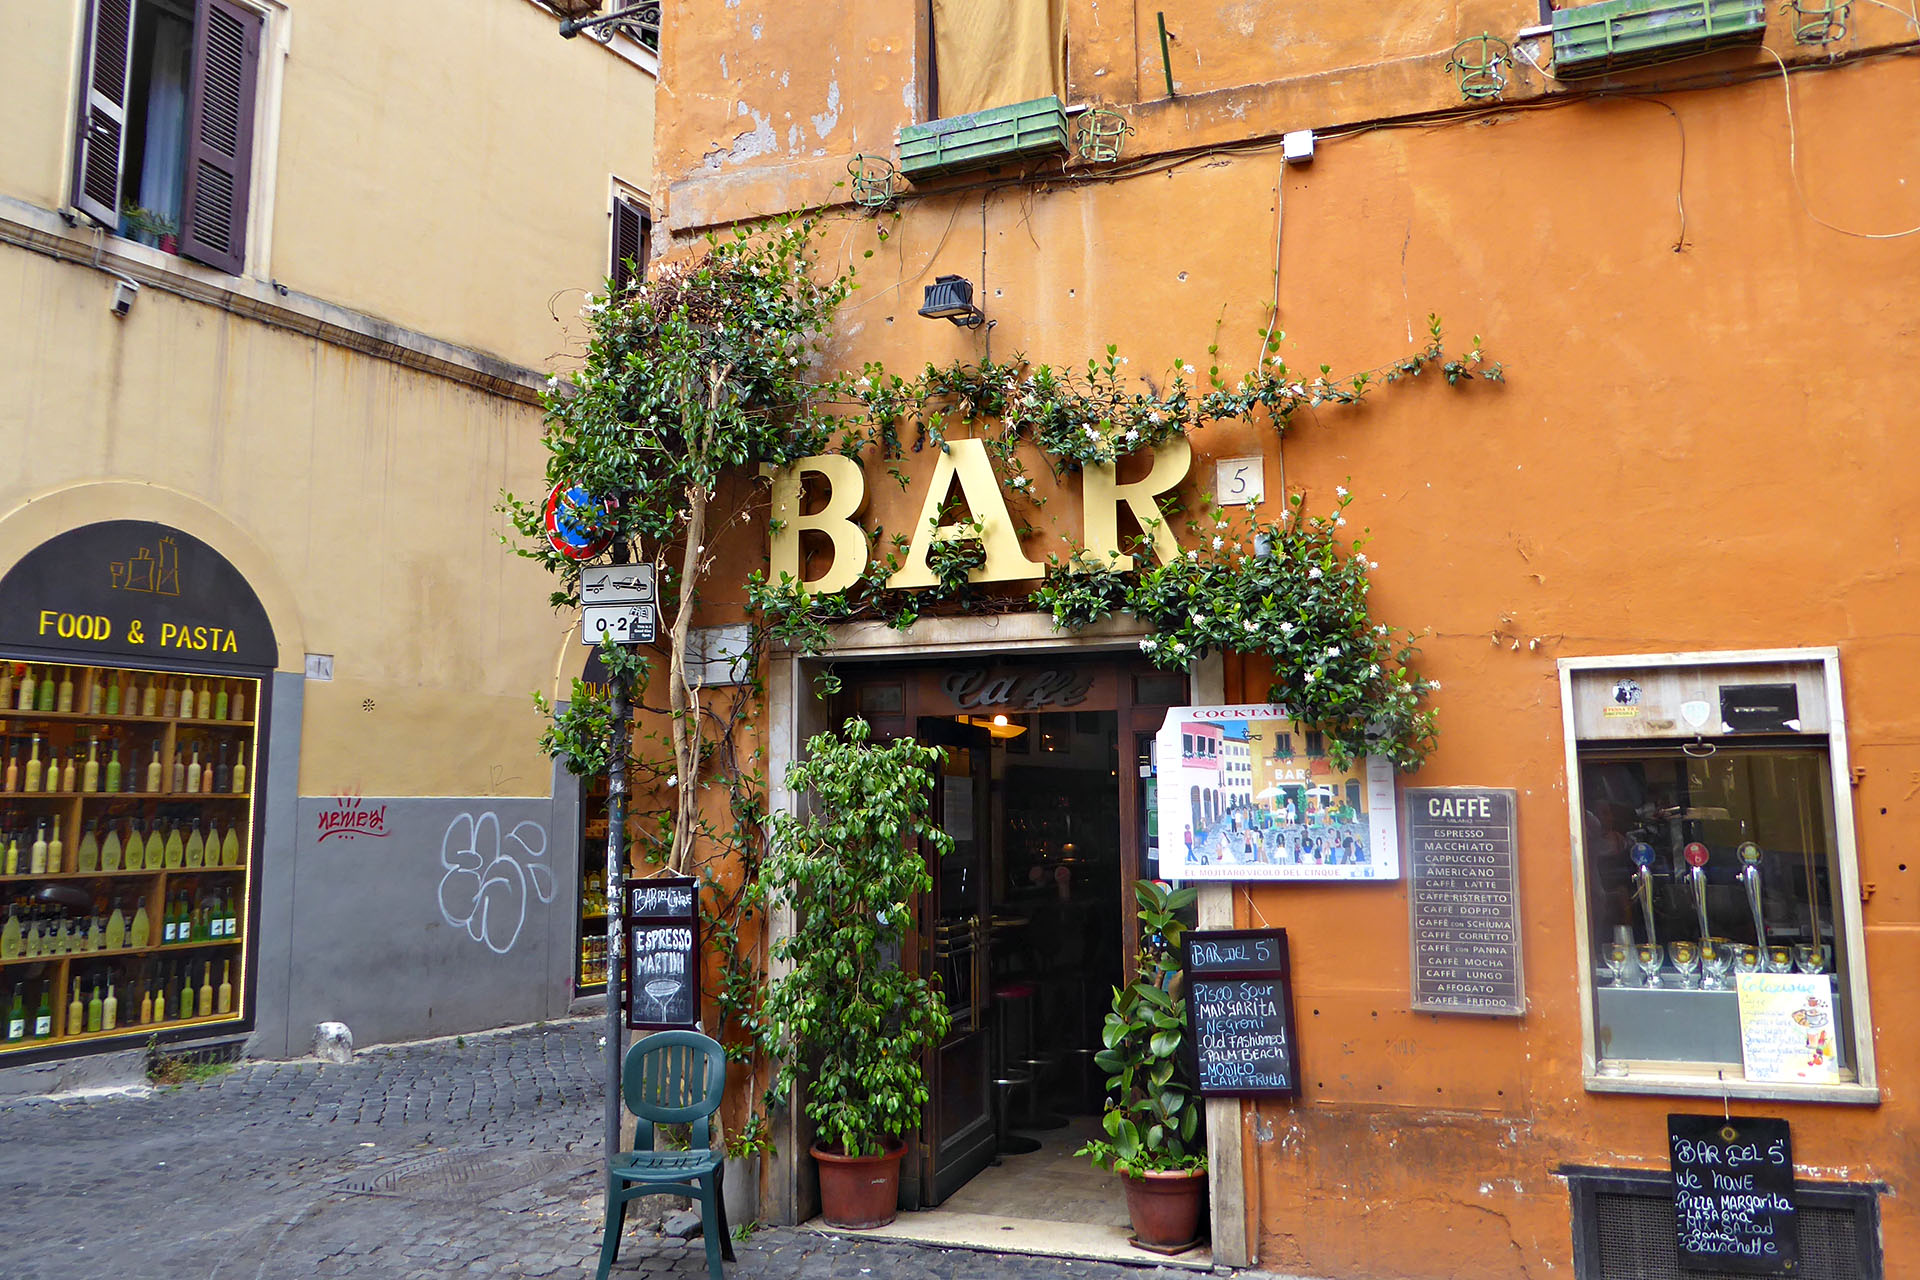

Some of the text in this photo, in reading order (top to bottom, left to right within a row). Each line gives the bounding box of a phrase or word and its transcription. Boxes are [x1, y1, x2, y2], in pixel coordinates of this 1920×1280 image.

[1230, 465, 1249, 495] 5
[760, 436, 1191, 595] BAR
[39, 610, 238, 654] FOOD & PASTA
[1274, 768, 1305, 781] BAR
[1434, 829, 1485, 838] ESPRESSO
[1424, 842, 1494, 852] MACCHIATO
[1424, 854, 1495, 864] CAPPUCCINO
[1283, 869, 1301, 877] DEL
[1304, 869, 1341, 877] CINQUE
[1426, 867, 1495, 877] AMERICANO
[1464, 880, 1497, 889] LATTE
[632, 887, 657, 914] BAR
[1452, 893, 1507, 903] RISTRETTO
[1460, 906, 1500, 916] DOPPIO
[1466, 920, 1511, 929] SCHIUMA
[635, 928, 692, 952] ESPRESSO
[1458, 932, 1509, 941] CORRETTO
[1473, 945, 1507, 955] PANNA
[636, 951, 685, 976] MARTINI
[1464, 958, 1504, 967] MOCHA
[1466, 971, 1503, 980] LUNGO
[1240, 982, 1274, 1001] Sour
[1437, 983, 1494, 993] AFFOGATO
[1466, 997, 1507, 1008] FREDDO
[1202, 1032, 1226, 1049] Old
[1203, 1049, 1238, 1062] PALM
